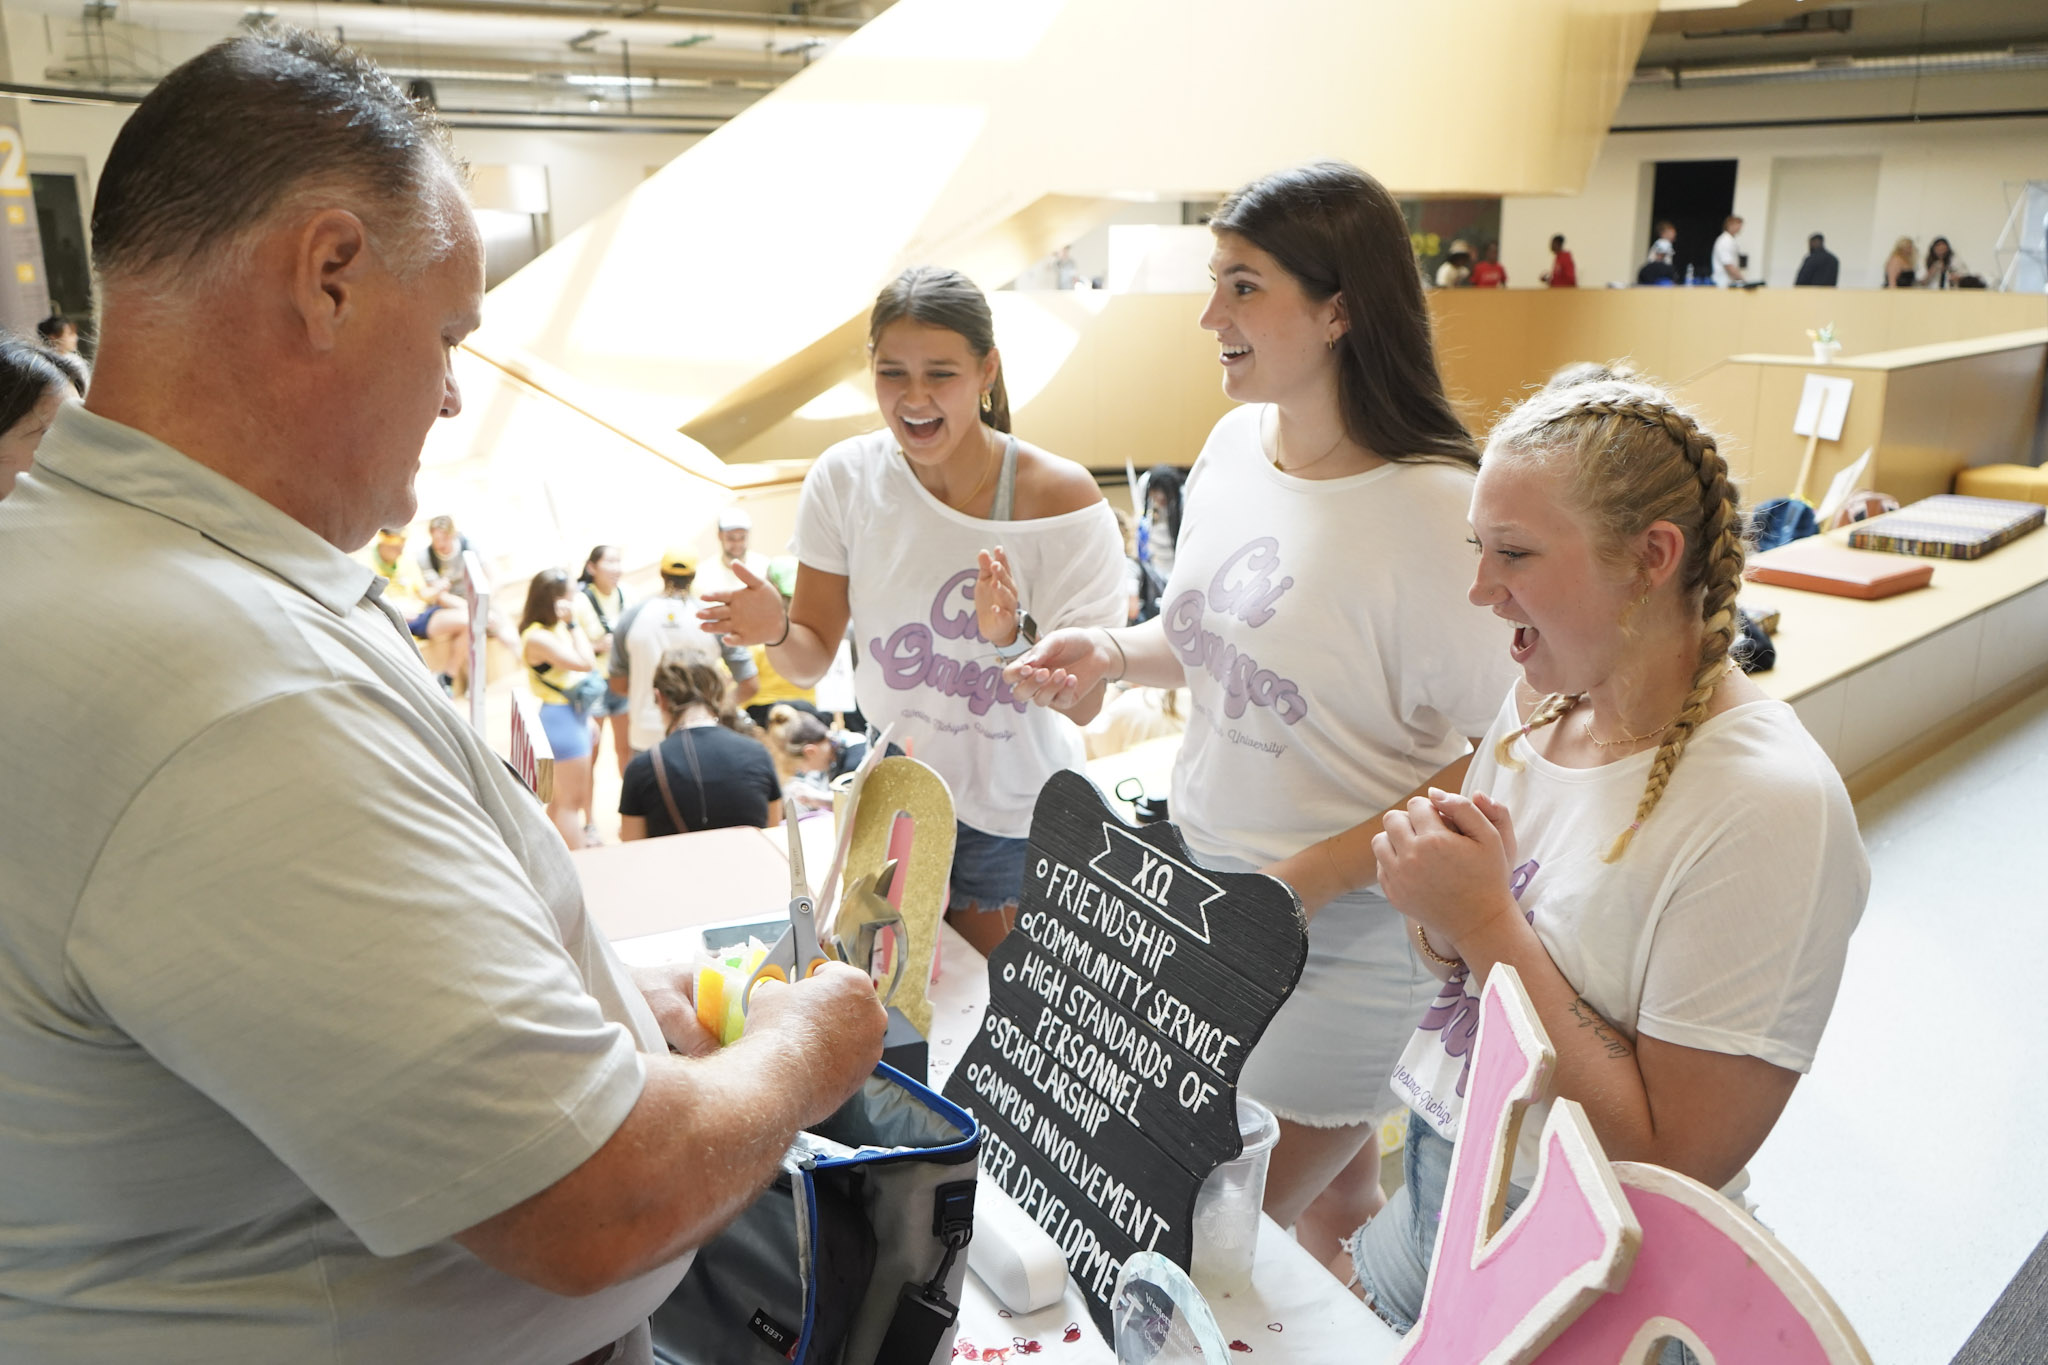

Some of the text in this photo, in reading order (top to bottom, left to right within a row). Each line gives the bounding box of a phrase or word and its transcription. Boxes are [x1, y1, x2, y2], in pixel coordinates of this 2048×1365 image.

[1208, 537, 1294, 628] Chi
[1046, 863, 1177, 977] FRIENDSHIP
[1019, 951, 1219, 1113] HIGH STANDARDS OF
[1030, 912, 1240, 1076] COMMUNITY SERVICE
[991, 1017, 1110, 1138] SCHOLARSHIP
[1034, 1006, 1142, 1128] PERSONNEL
[975, 1064, 1170, 1252] CAMPUS INVOLVEMENT
